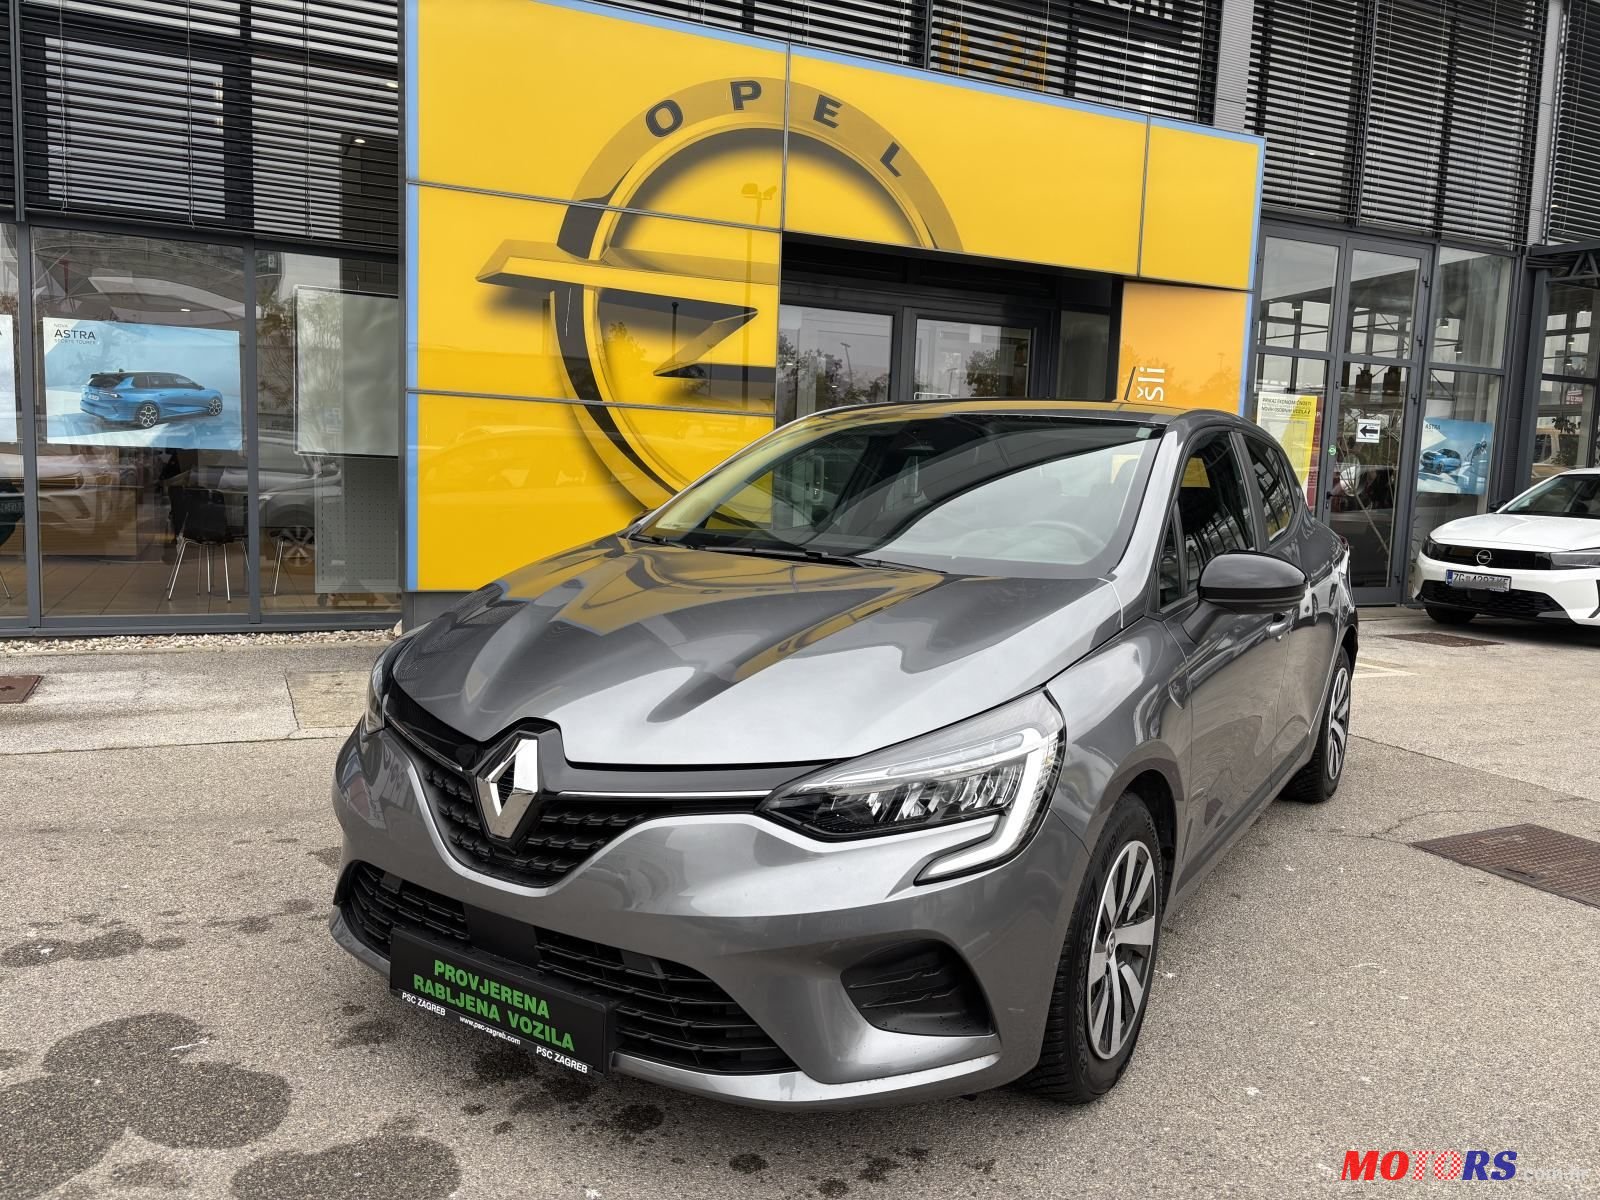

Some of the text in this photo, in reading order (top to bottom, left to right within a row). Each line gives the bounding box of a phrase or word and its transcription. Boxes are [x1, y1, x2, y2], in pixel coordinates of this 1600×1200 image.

[646, 79, 904, 178] OPEL
[54, 328, 96, 340] ASTRA
[401, 991, 446, 1016] PSC ZAGREB
[434, 959, 550, 1019] PROVJERENA
[413, 973, 575, 1052] RABLJENA VOZILA
[459, 1015, 521, 1045] www.psc-zagreb.com
[536, 1045, 588, 1074] PSC ZAGREB
